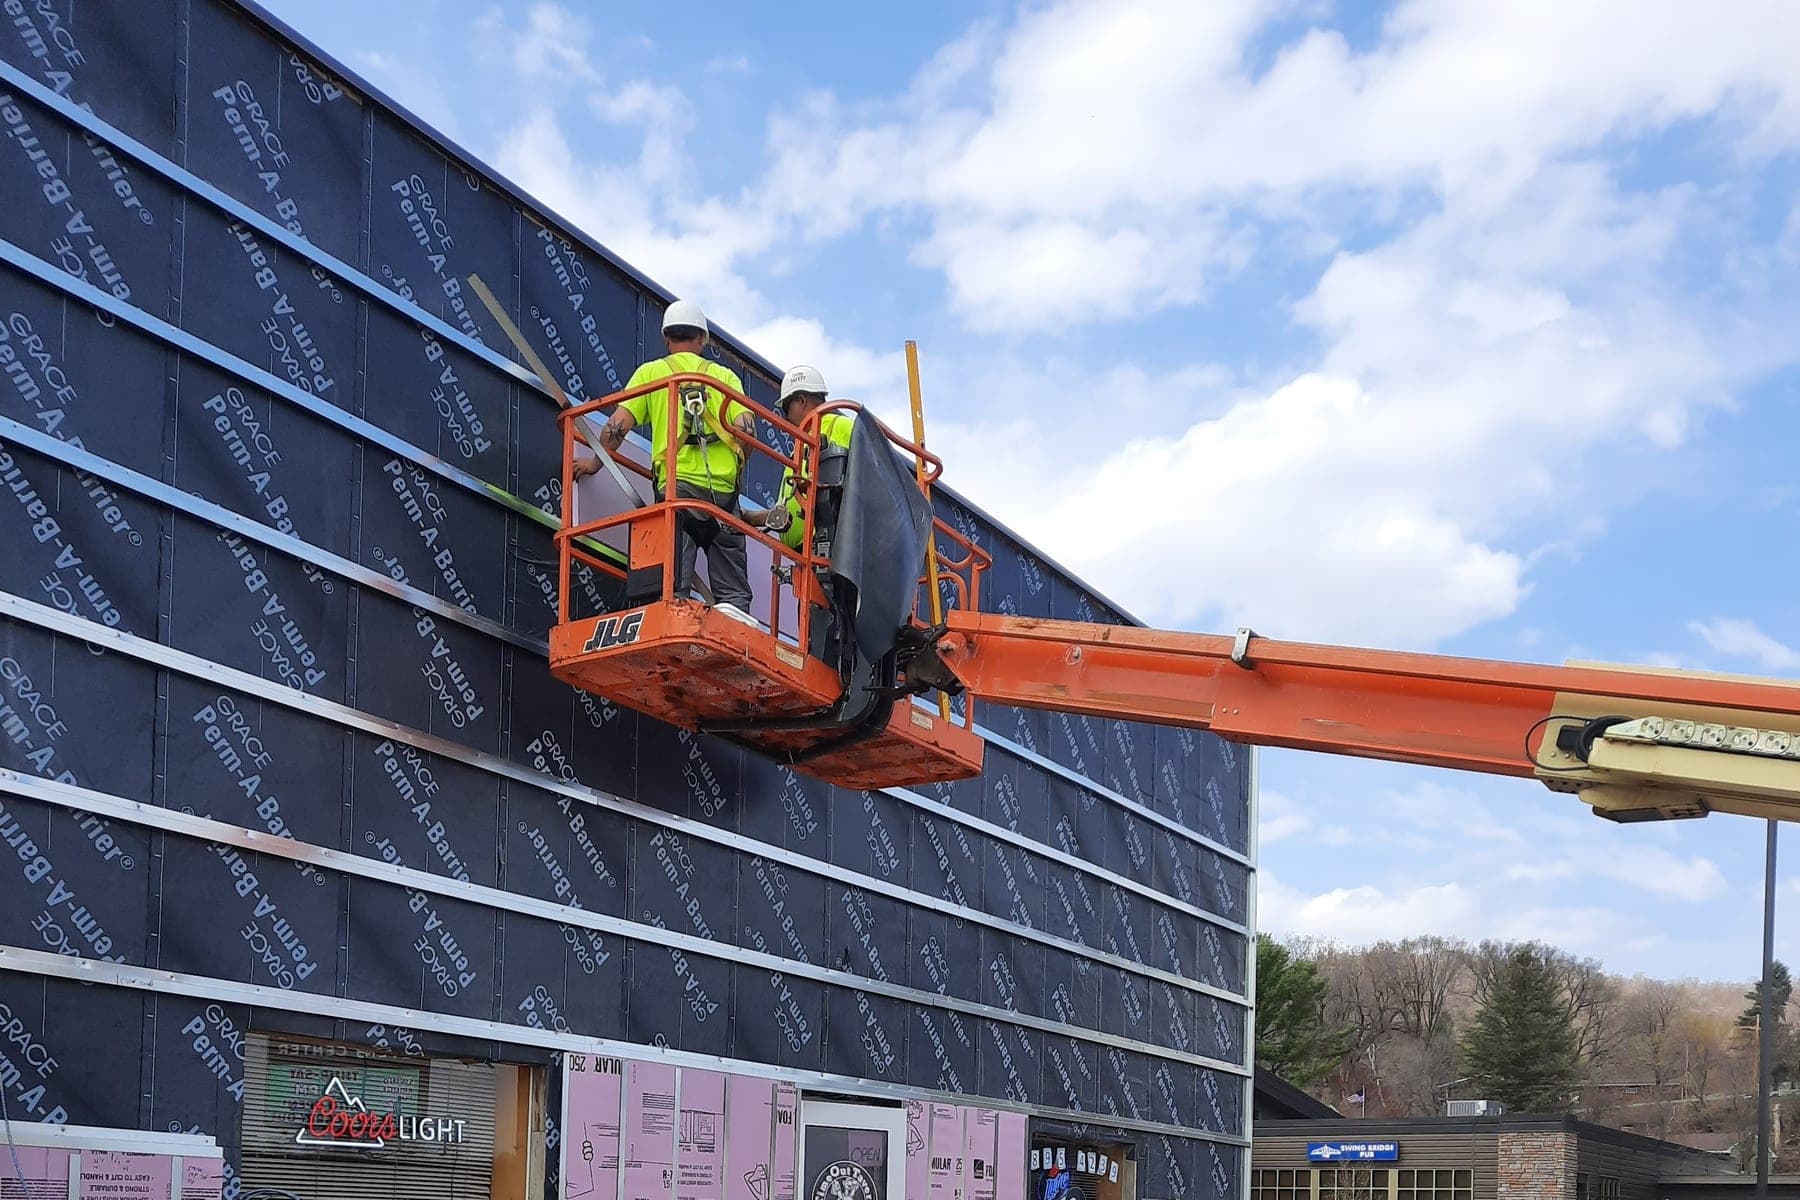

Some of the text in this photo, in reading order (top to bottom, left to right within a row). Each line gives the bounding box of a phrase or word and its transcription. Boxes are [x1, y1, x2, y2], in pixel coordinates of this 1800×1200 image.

[37, 0, 86, 69] RACE
[291, 54, 321, 104] GRA
[235, 79, 290, 169] GRACE
[410, 173, 455, 250] GRACE
[559, 239, 592, 290] RACE
[10, 312, 78, 404] GRACE
[227, 387, 282, 468] GRACE
[430, 386, 473, 459] GRACE
[383, 460, 478, 615] Perm-A-Barrie
[251, 619, 304, 692] GRACE
[583, 611, 647, 653] JLG
[0, 657, 68, 741] GRACE
[421, 661, 466, 728] GRACE
[217, 696, 274, 771] GRACE
[375, 741, 471, 883] Perm-A-Barrie
[683, 762, 714, 818] GRACE
[780, 790, 807, 841] GRACE
[1002, 774, 1021, 816] GRACE
[867, 831, 890, 876] GRACE
[1061, 815, 1080, 853] GRACE
[751, 855, 810, 964] Perm-A-Barrie
[241, 922, 294, 989] GRACE
[414, 935, 458, 997] GRACE
[929, 936, 951, 980] GRACE
[997, 952, 1017, 992] GRACE
[535, 985, 573, 1034] GRAC
[1058, 983, 1076, 1020] GRACE
[773, 1007, 801, 1053] GRACE
[863, 1032, 885, 1074] GRACE
[569, 1055, 621, 1075] 250 ULAR
[308, 1096, 466, 1144] Coors LIGHT
[851, 1147, 881, 1163] OPEN
[1341, 1144, 1394, 1152] SWING BRIDGE
